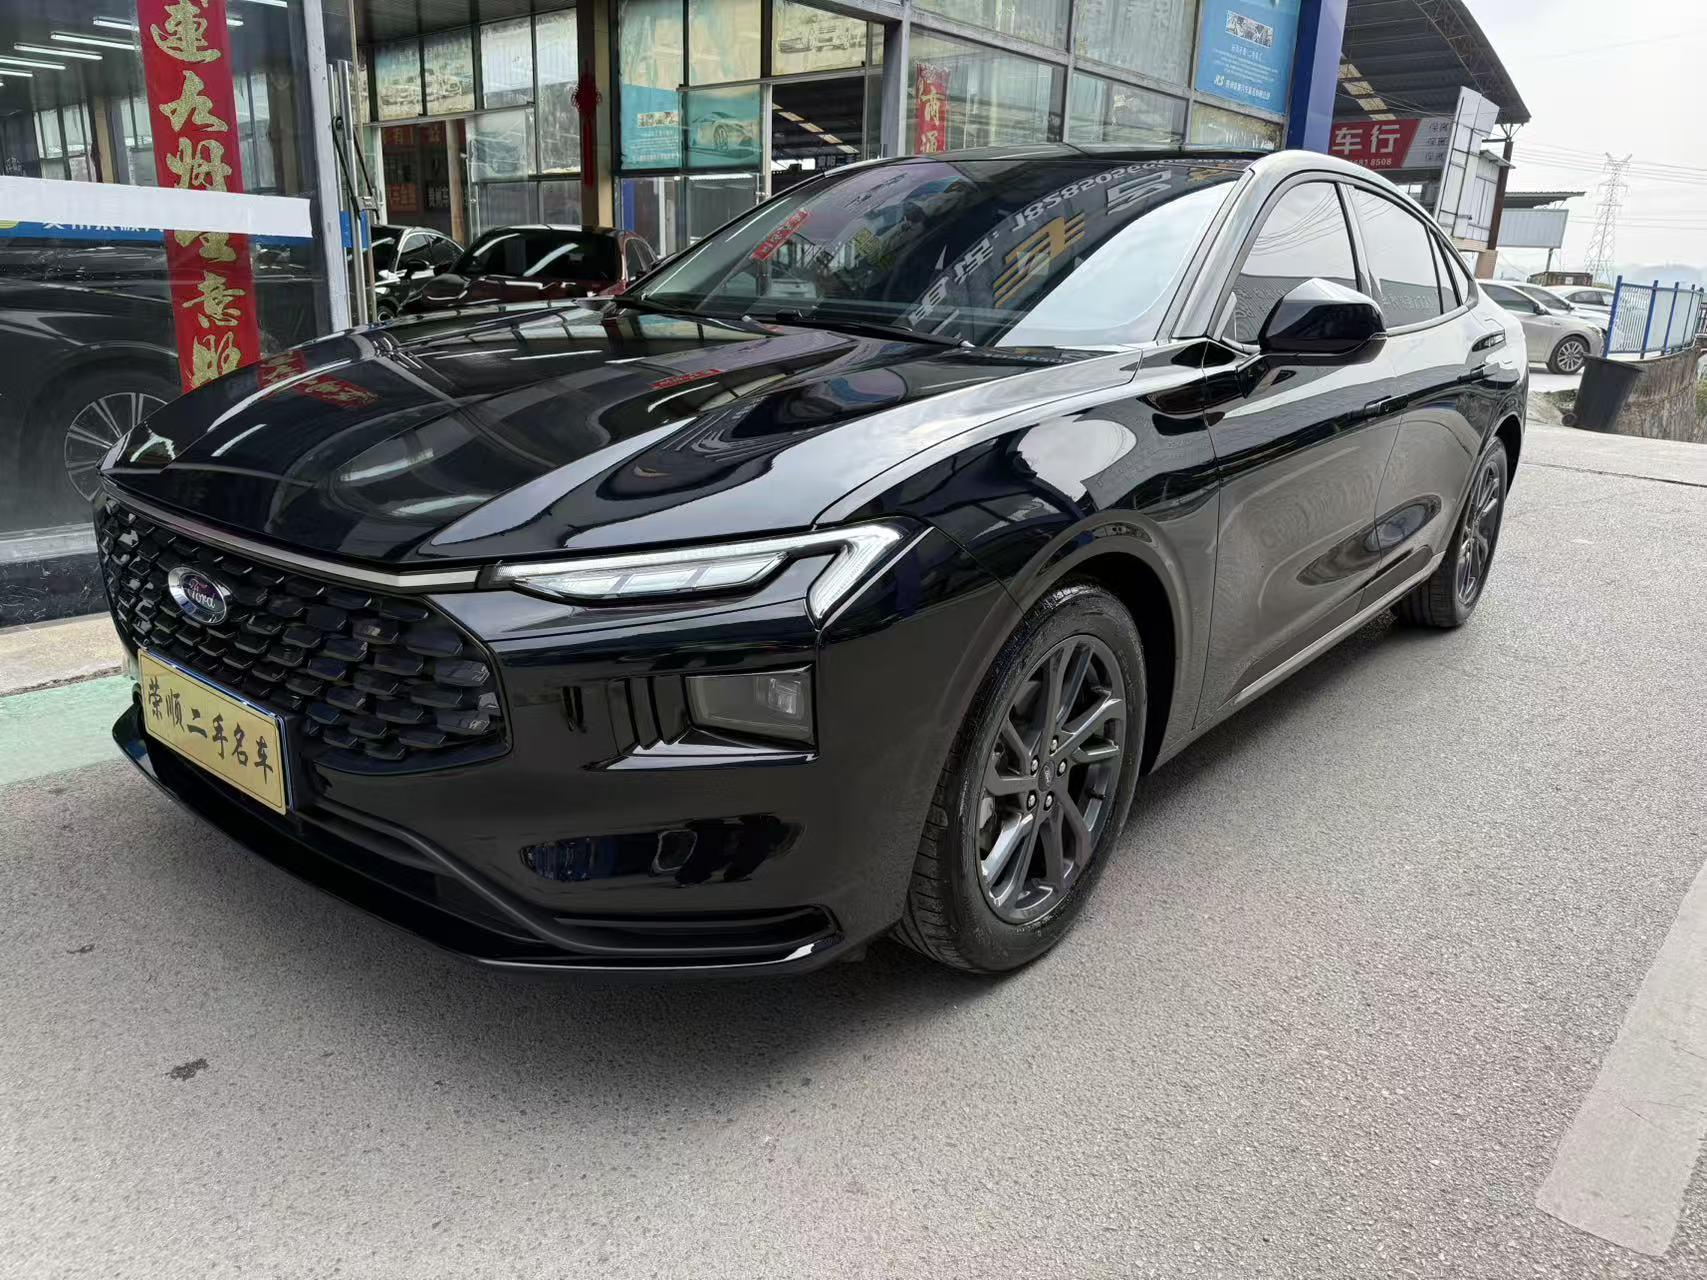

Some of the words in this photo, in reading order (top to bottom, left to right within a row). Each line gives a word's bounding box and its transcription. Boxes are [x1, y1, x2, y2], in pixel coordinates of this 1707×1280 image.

[1332, 124, 1401, 155] 车行
[187, 578, 216, 609] Ford
[147, 675, 274, 785] 荣顺二手名车
